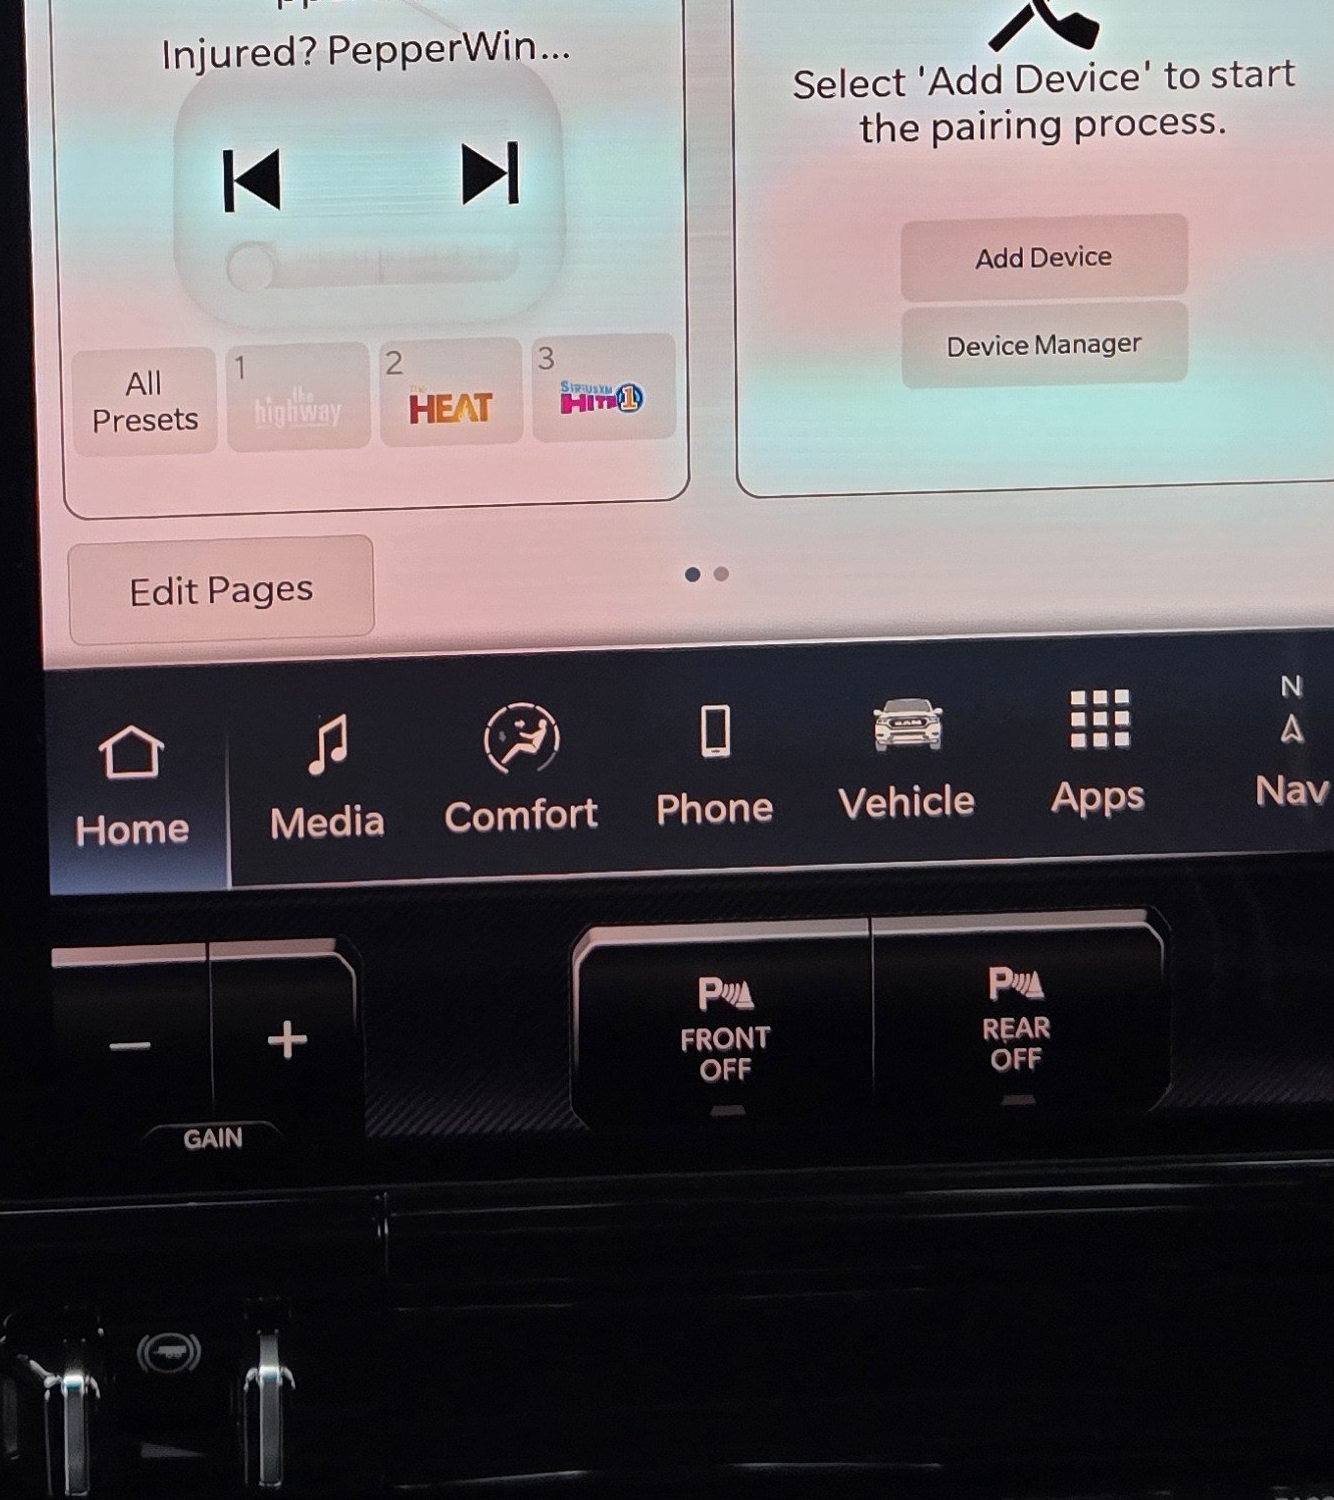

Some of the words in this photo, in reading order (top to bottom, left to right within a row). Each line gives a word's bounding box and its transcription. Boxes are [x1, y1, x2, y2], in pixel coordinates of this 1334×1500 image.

[162, 35, 318, 75] Injured?
[793, 67, 906, 100] Select
[920, 63, 1003, 96] 'Add
[1016, 60, 1151, 94] Device'
[1164, 60, 1200, 90] to
[1210, 57, 1296, 89] start
[860, 112, 920, 145] the
[932, 108, 1062, 148] pairing
[1074, 107, 1226, 142] process.
[975, 247, 1024, 270] Add
[1031, 245, 1113, 269] Device
[538, 346, 556, 371] 3
[948, 335, 1028, 357] Device
[1035, 332, 1142, 359] Manager
[235, 355, 246, 380] 1
[385, 351, 404, 375] 2
[125, 370, 162, 397] All
[92, 409, 199, 435] Presets
[254, 399, 342, 429] highway
[409, 392, 493, 425] HEAT
[130, 578, 198, 607] Edit
[208, 573, 314, 610] Pages
[838, 784, 976, 820] Vehicle
[1051, 780, 1145, 817] Apps
[1255, 775, 1331, 807] Nav
[270, 805, 385, 841] Media
[444, 797, 599, 835] Comfort
[657, 793, 774, 825] Phone
[76, 815, 190, 846] Home
[682, 1026, 771, 1051] FRONT
[983, 1017, 1050, 1040] REAR
[700, 1059, 751, 1082] OFF
[991, 1047, 1042, 1072] OFF
[184, 1129, 243, 1150] GAIN
